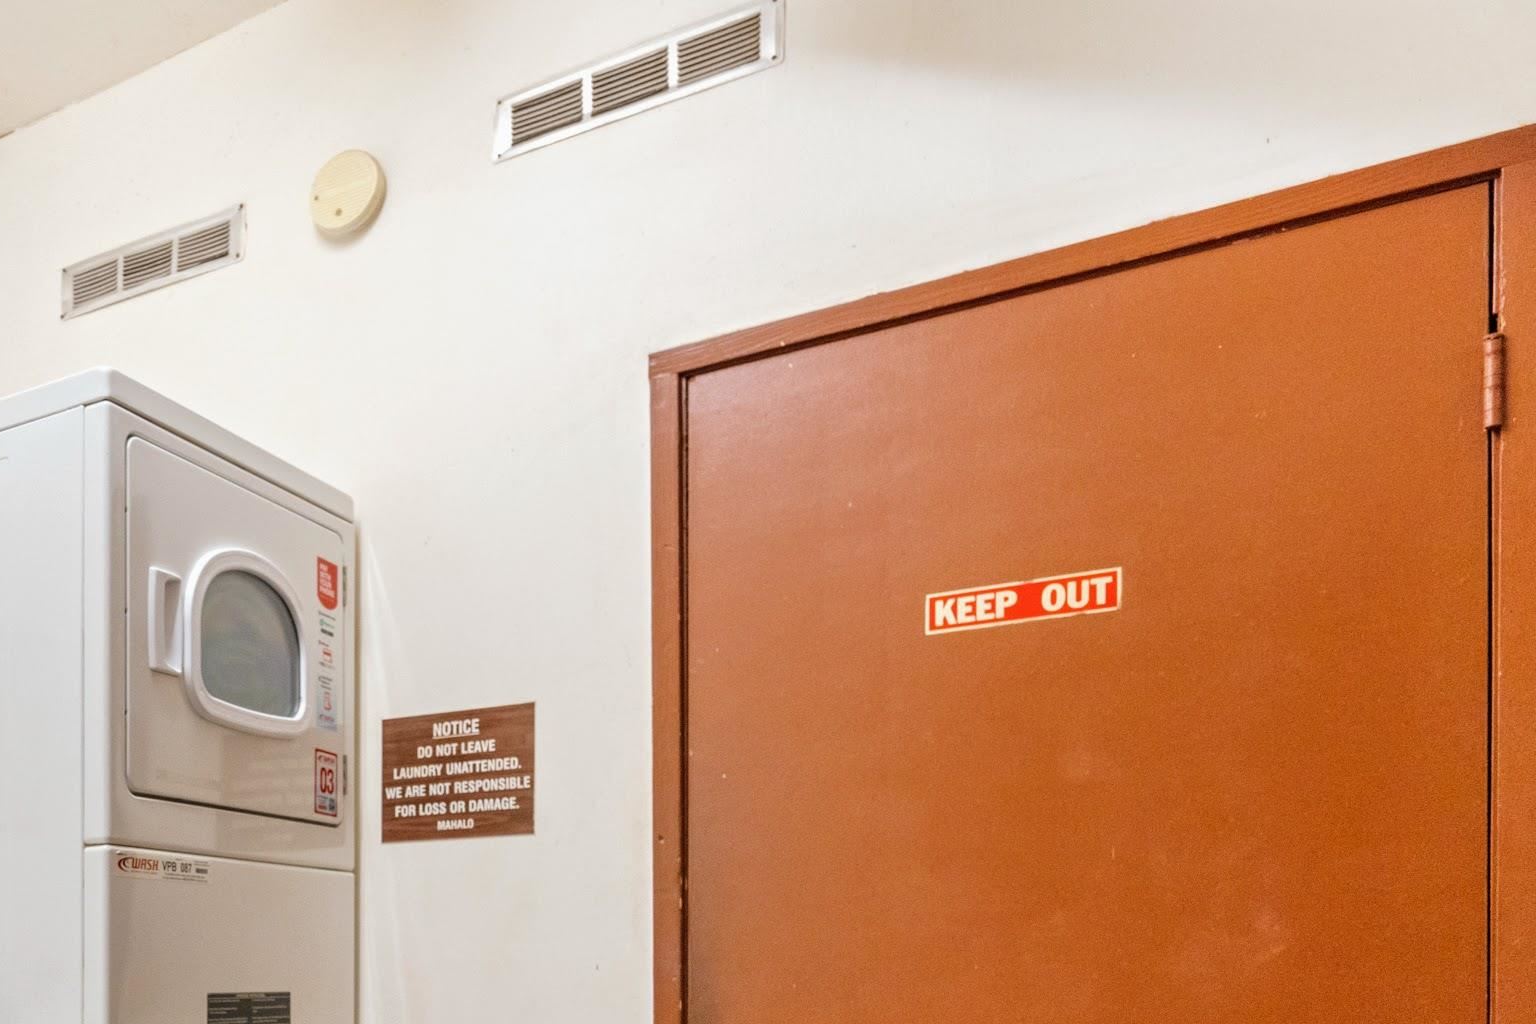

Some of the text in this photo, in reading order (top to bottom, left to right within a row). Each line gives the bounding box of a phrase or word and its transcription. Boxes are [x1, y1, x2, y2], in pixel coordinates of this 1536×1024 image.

[934, 576, 1113, 627] KEEP OUT
[433, 718, 480, 738] NOTICE
[417, 739, 496, 759] DO NOT LEAVE
[393, 757, 522, 780] LAUNDRY UNATTENDED.
[320, 767, 334, 794] 03
[385, 776, 531, 799] WE ARE NOT RESPONSIBLE
[395, 797, 520, 818] FOR LOSS OR DAMAGE.
[437, 818, 474, 831] MAHALO
[131, 858, 159, 871] WASH
[161, 861, 177, 872] VPB
